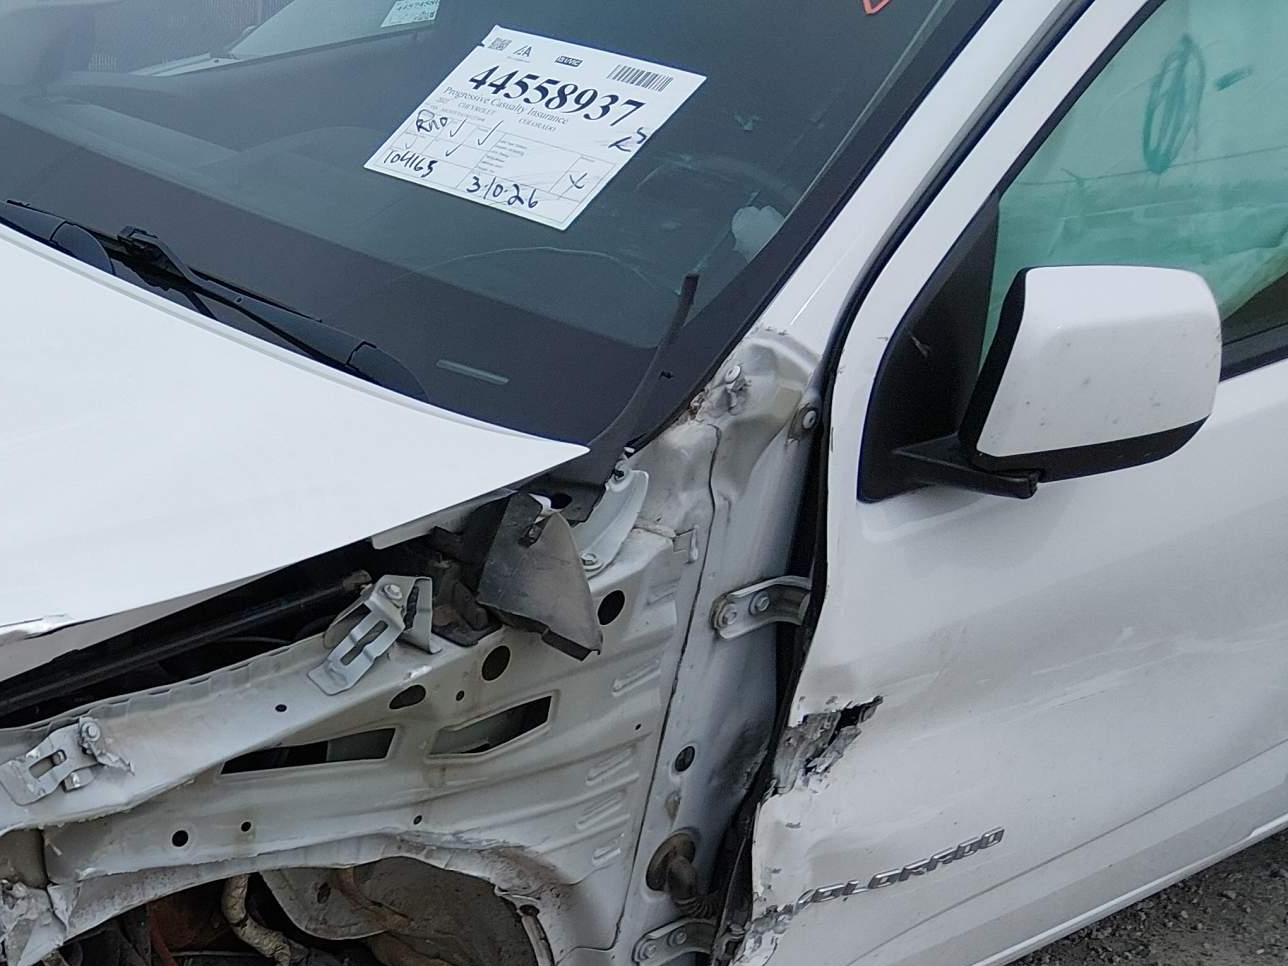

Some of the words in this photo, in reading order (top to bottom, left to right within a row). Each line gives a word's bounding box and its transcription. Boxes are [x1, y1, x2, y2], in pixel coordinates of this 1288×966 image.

[444, 86, 489, 103] Progressive
[492, 97, 526, 114] Casualty
[527, 105, 569, 125] Insurance
[469, 65, 646, 126] 44558937
